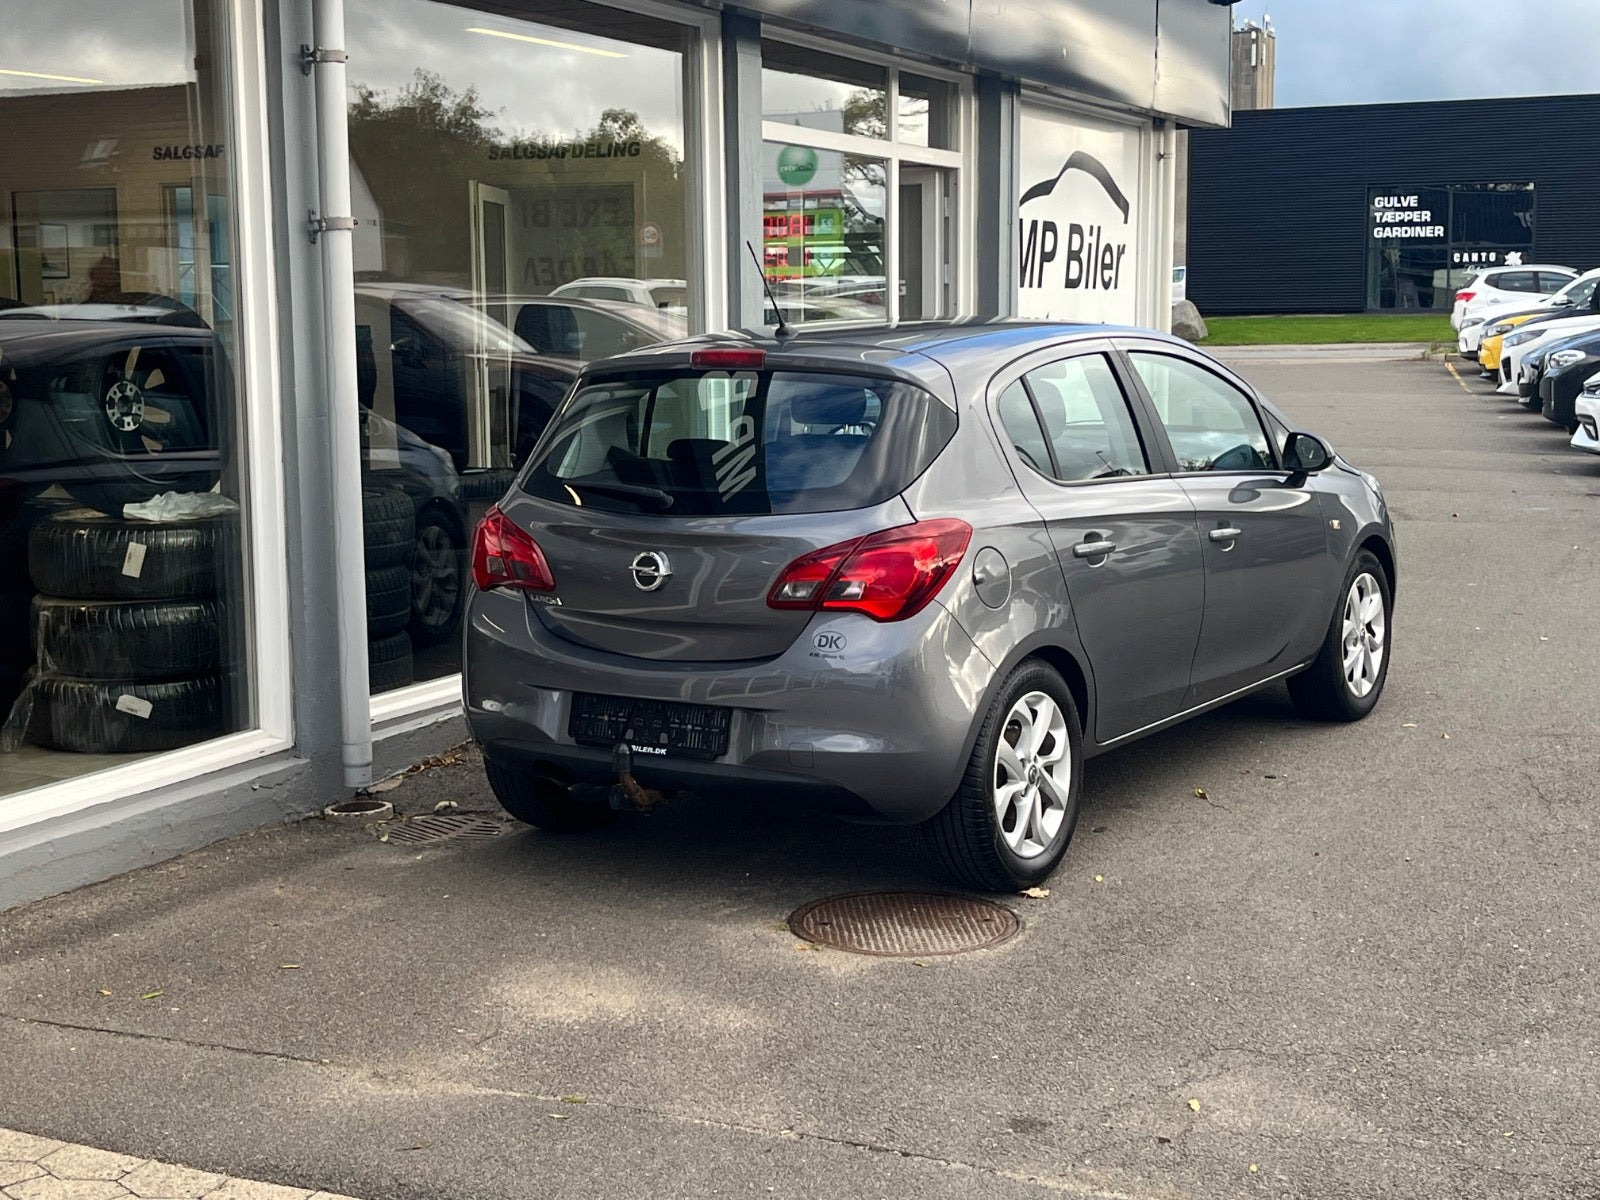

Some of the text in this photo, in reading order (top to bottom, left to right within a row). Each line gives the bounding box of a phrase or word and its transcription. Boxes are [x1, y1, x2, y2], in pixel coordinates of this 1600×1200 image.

[488, 142, 641, 160] SALGSAFDELING
[1374, 195, 1418, 208] GULVE
[1374, 210, 1431, 223] TÆPPER
[1373, 225, 1445, 238] GARDINER
[1019, 217, 1126, 291] MP Biler
[1453, 252, 1497, 263] CANTO
[817, 634, 842, 649] DK
